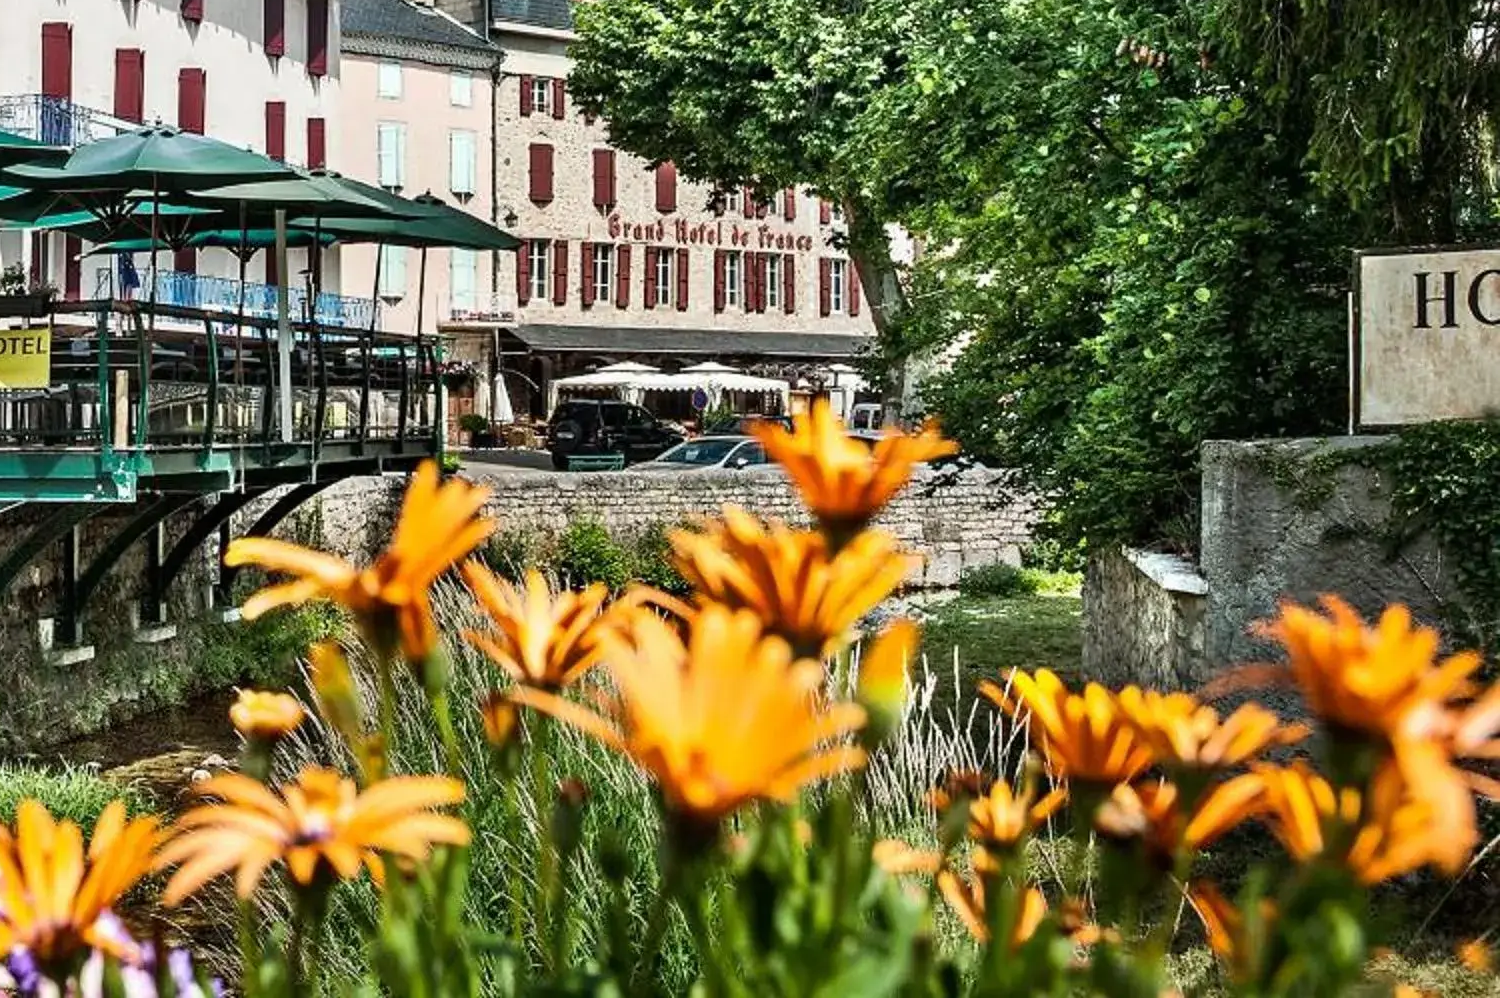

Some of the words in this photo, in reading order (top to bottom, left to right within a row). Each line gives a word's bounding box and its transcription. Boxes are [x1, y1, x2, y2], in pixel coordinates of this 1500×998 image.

[608, 213, 664, 242] Grand
[732, 224, 750, 247] de
[758, 223, 813, 251] France
